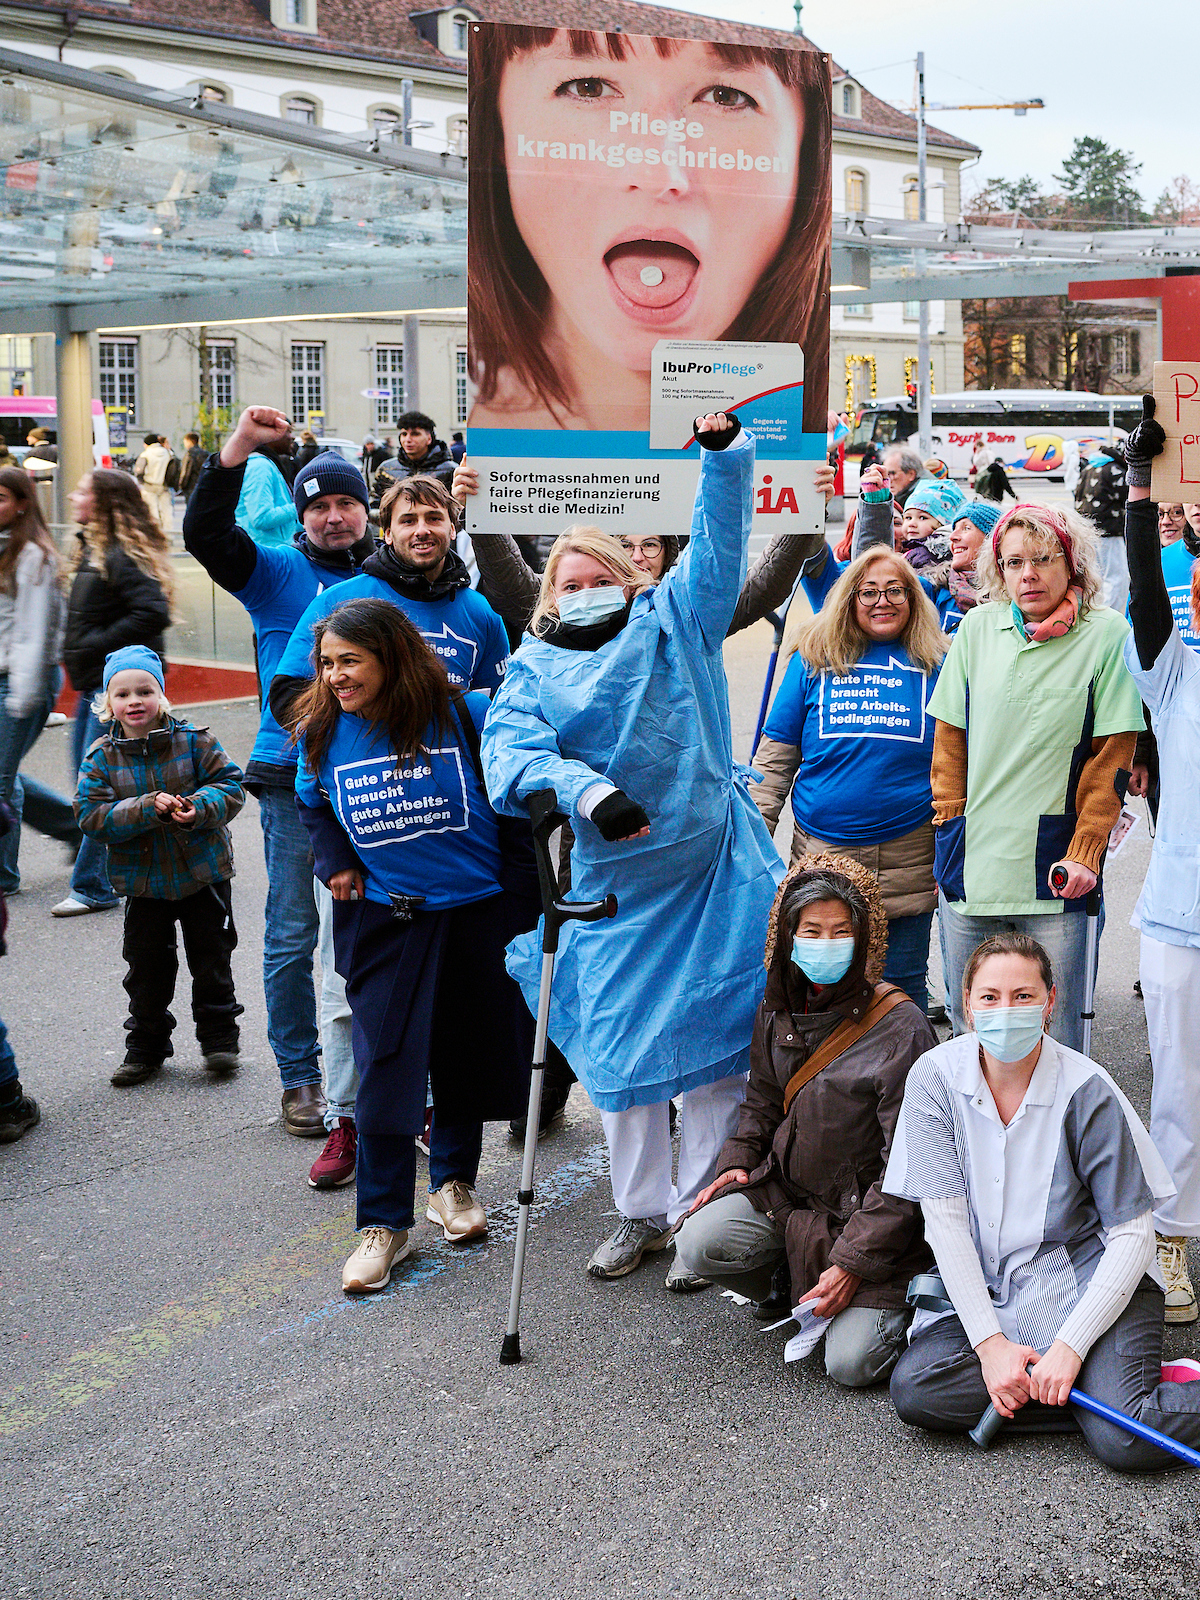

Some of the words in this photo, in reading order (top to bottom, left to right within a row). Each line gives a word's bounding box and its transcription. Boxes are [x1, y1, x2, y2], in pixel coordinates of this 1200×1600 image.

[610, 111, 704, 142] Pflege
[518, 135, 789, 173] krankgeschrieben
[753, 418, 773, 426] Gegen
[987, 432, 1015, 443] Bern
[490, 472, 630, 484] Sofortmassnahmen
[634, 473, 660, 484] und
[490, 487, 522, 499] faire
[528, 488, 660, 502] Pflegefinanzierung
[490, 503, 534, 514] heisst
[538, 503, 560, 514] die
[565, 503, 624, 514] Medizin!
[832, 676, 861, 685] Gute
[864, 675, 903, 688] Pflege
[831, 688, 879, 698] braucht
[830, 701, 858, 713] gute
[861, 700, 911, 713] Arbeits-
[830, 714, 910, 727] bedingungen
[344, 775, 378, 790] Gute
[382, 765, 431, 784] Pflege
[347, 785, 404, 807] braucht
[351, 807, 382, 823] gute
[385, 797, 449, 815] Arbeits-
[355, 809, 450, 836] bedingungen
